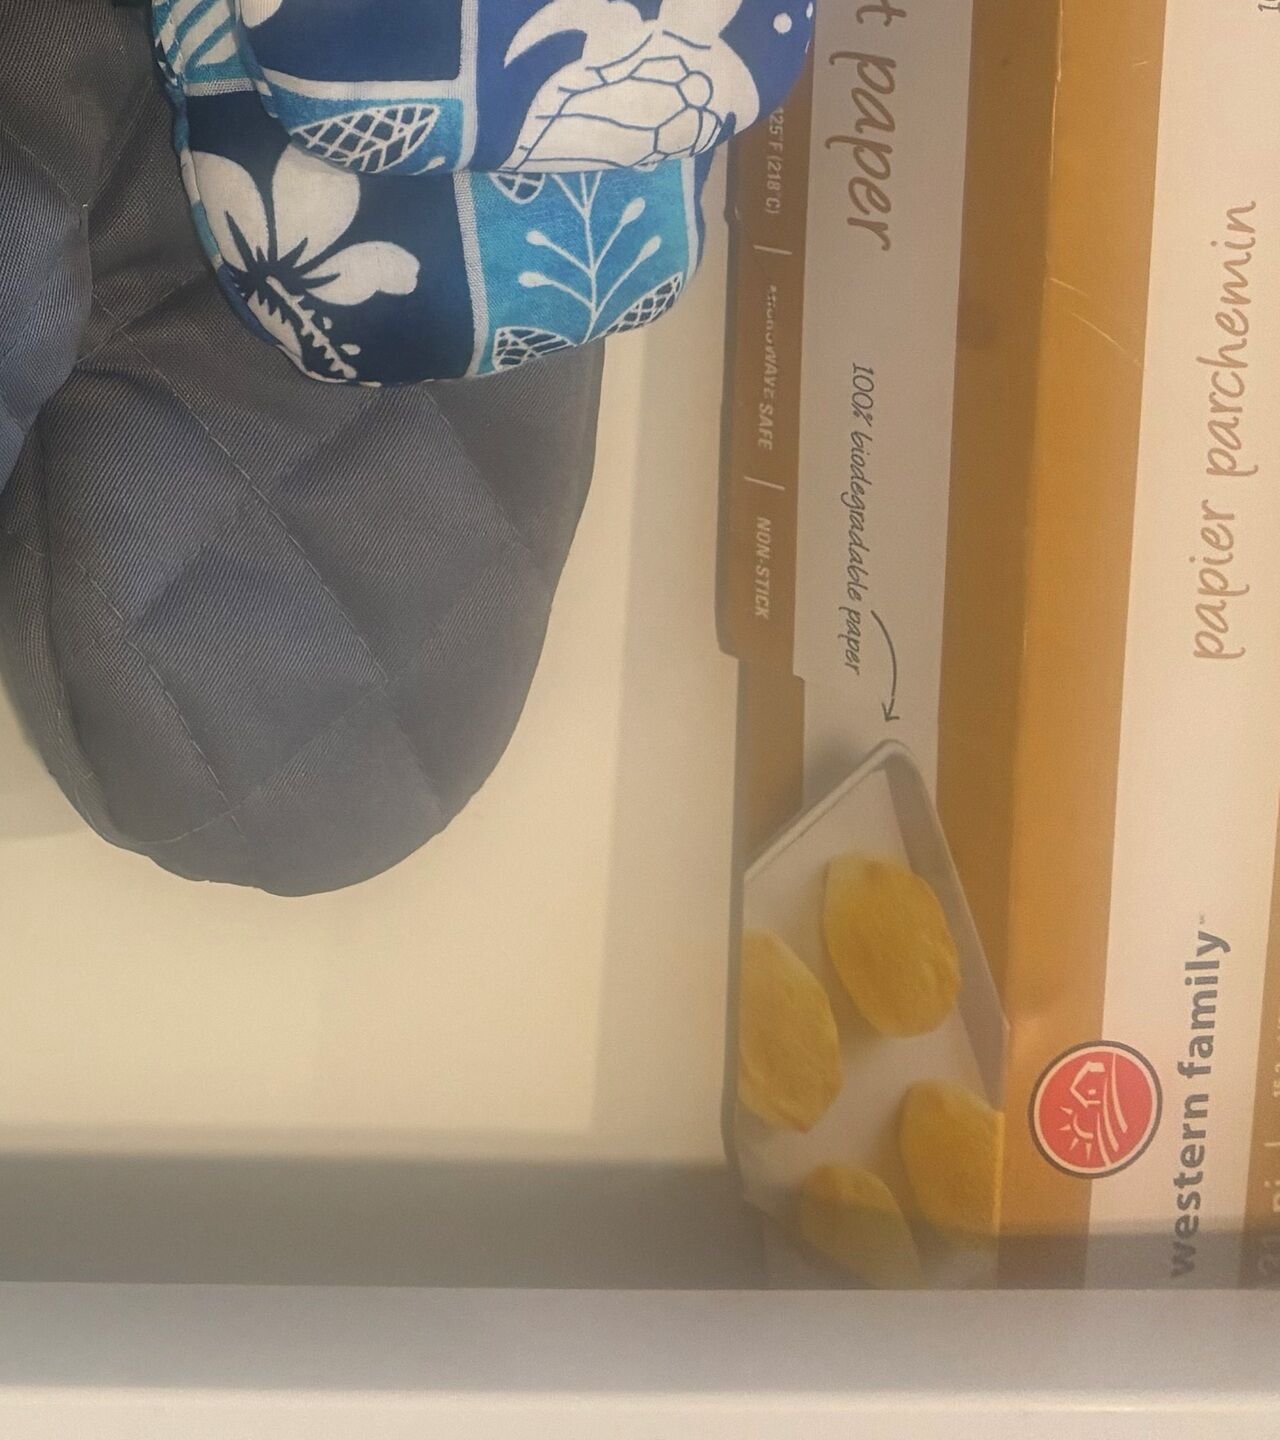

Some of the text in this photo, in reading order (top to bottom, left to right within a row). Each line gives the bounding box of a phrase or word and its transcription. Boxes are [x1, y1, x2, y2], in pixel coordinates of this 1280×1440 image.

[826, 50, 905, 251] paper
[758, 402, 773, 450] SAFE
[838, 362, 875, 674] 100% biodegradable paper
[1189, 200, 1259, 660] papier parchemin
[754, 515, 772, 620] NON-STICK
[1170, 930, 1231, 1279] western family
